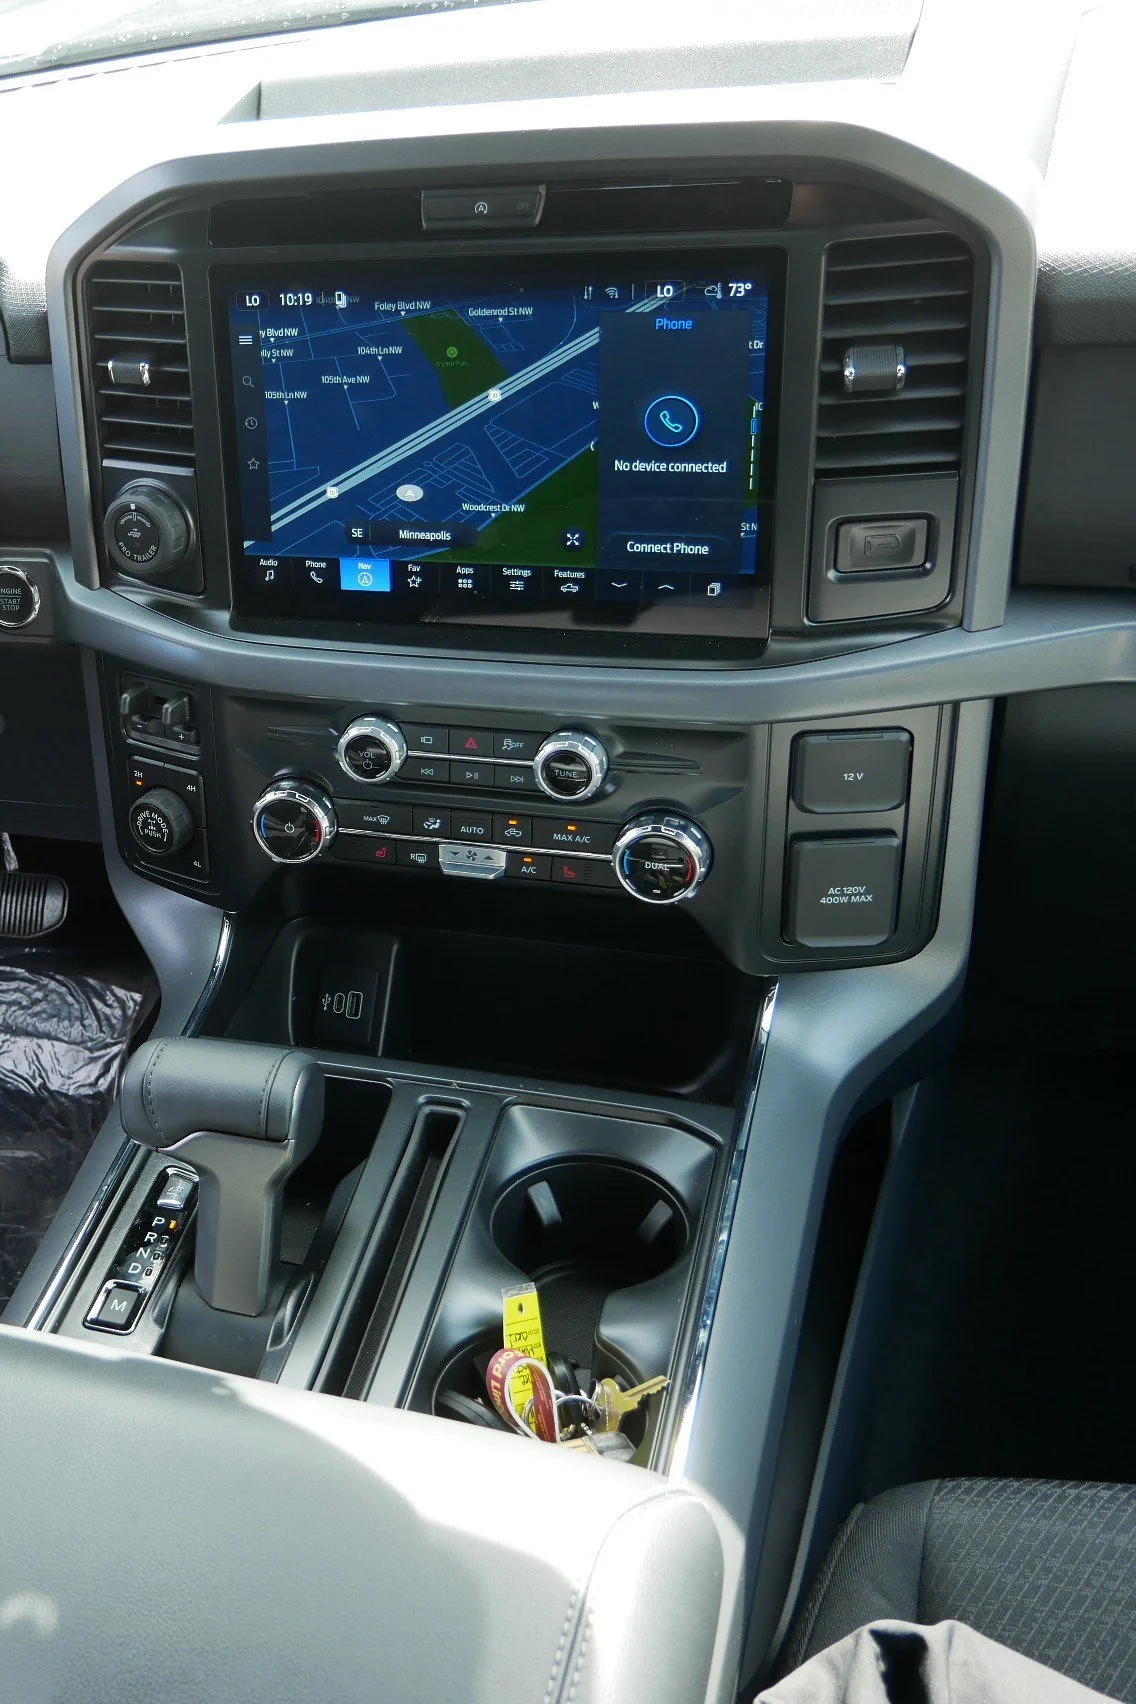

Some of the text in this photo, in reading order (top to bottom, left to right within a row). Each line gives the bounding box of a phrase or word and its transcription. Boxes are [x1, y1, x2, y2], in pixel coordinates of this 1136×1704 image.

[657, 285, 673, 297] LO
[728, 283, 752, 297] 73°
[245, 296, 260, 306] LO
[279, 293, 312, 306] 10:19
[374, 301, 431, 312] Foley Blvd NW
[468, 307, 533, 316] Goldenrod St NW
[655, 318, 693, 330] Phone
[266, 328, 284, 337] Blvd
[284, 328, 299, 336] NW
[272, 349, 280, 357] St
[281, 349, 294, 357] NW
[358, 346, 403, 355] 104th Ln NW
[321, 375, 370, 384] 105th Ave NW
[264, 391, 307, 400] 105th Ln NW
[614, 459, 727, 473] No device connected
[461, 502, 525, 512] Woodcrest Dr NW
[351, 528, 363, 538] SE
[398, 529, 451, 541] Minneapolis
[118, 541, 158, 562] PRO TRAILER
[626, 541, 709, 555] Connect Phone
[259, 558, 278, 567] Audio
[305, 560, 327, 569] Phone
[358, 562, 371, 570] Nav
[408, 564, 421, 572] Fav
[456, 566, 474, 575] Apps
[502, 567, 532, 577] Settings
[554, 569, 585, 579] Features
[2, 604, 20, 612] STOP
[358, 751, 376, 759] VOL
[133, 770, 143, 779] 2H
[554, 769, 578, 778] TUNE
[843, 772, 864, 781] 12 V
[186, 784, 196, 793] 4H
[136, 810, 169, 834] DRIVE MODE
[363, 815, 377, 823] MAX
[144, 828, 162, 839] PUSH
[460, 826, 484, 834] AUTO
[553, 833, 591, 844] MAX A/C
[193, 860, 202, 868] 4L
[645, 861, 669, 871] DUAL
[521, 865, 536, 875] A/C
[828, 886, 866, 895] AC 120V
[820, 894, 873, 905] 400W MAX
[152, 1216, 165, 1227] P
[144, 1231, 157, 1243] R
[136, 1247, 151, 1259] N
[128, 1262, 141, 1274] D
[110, 1299, 127, 1312] M
